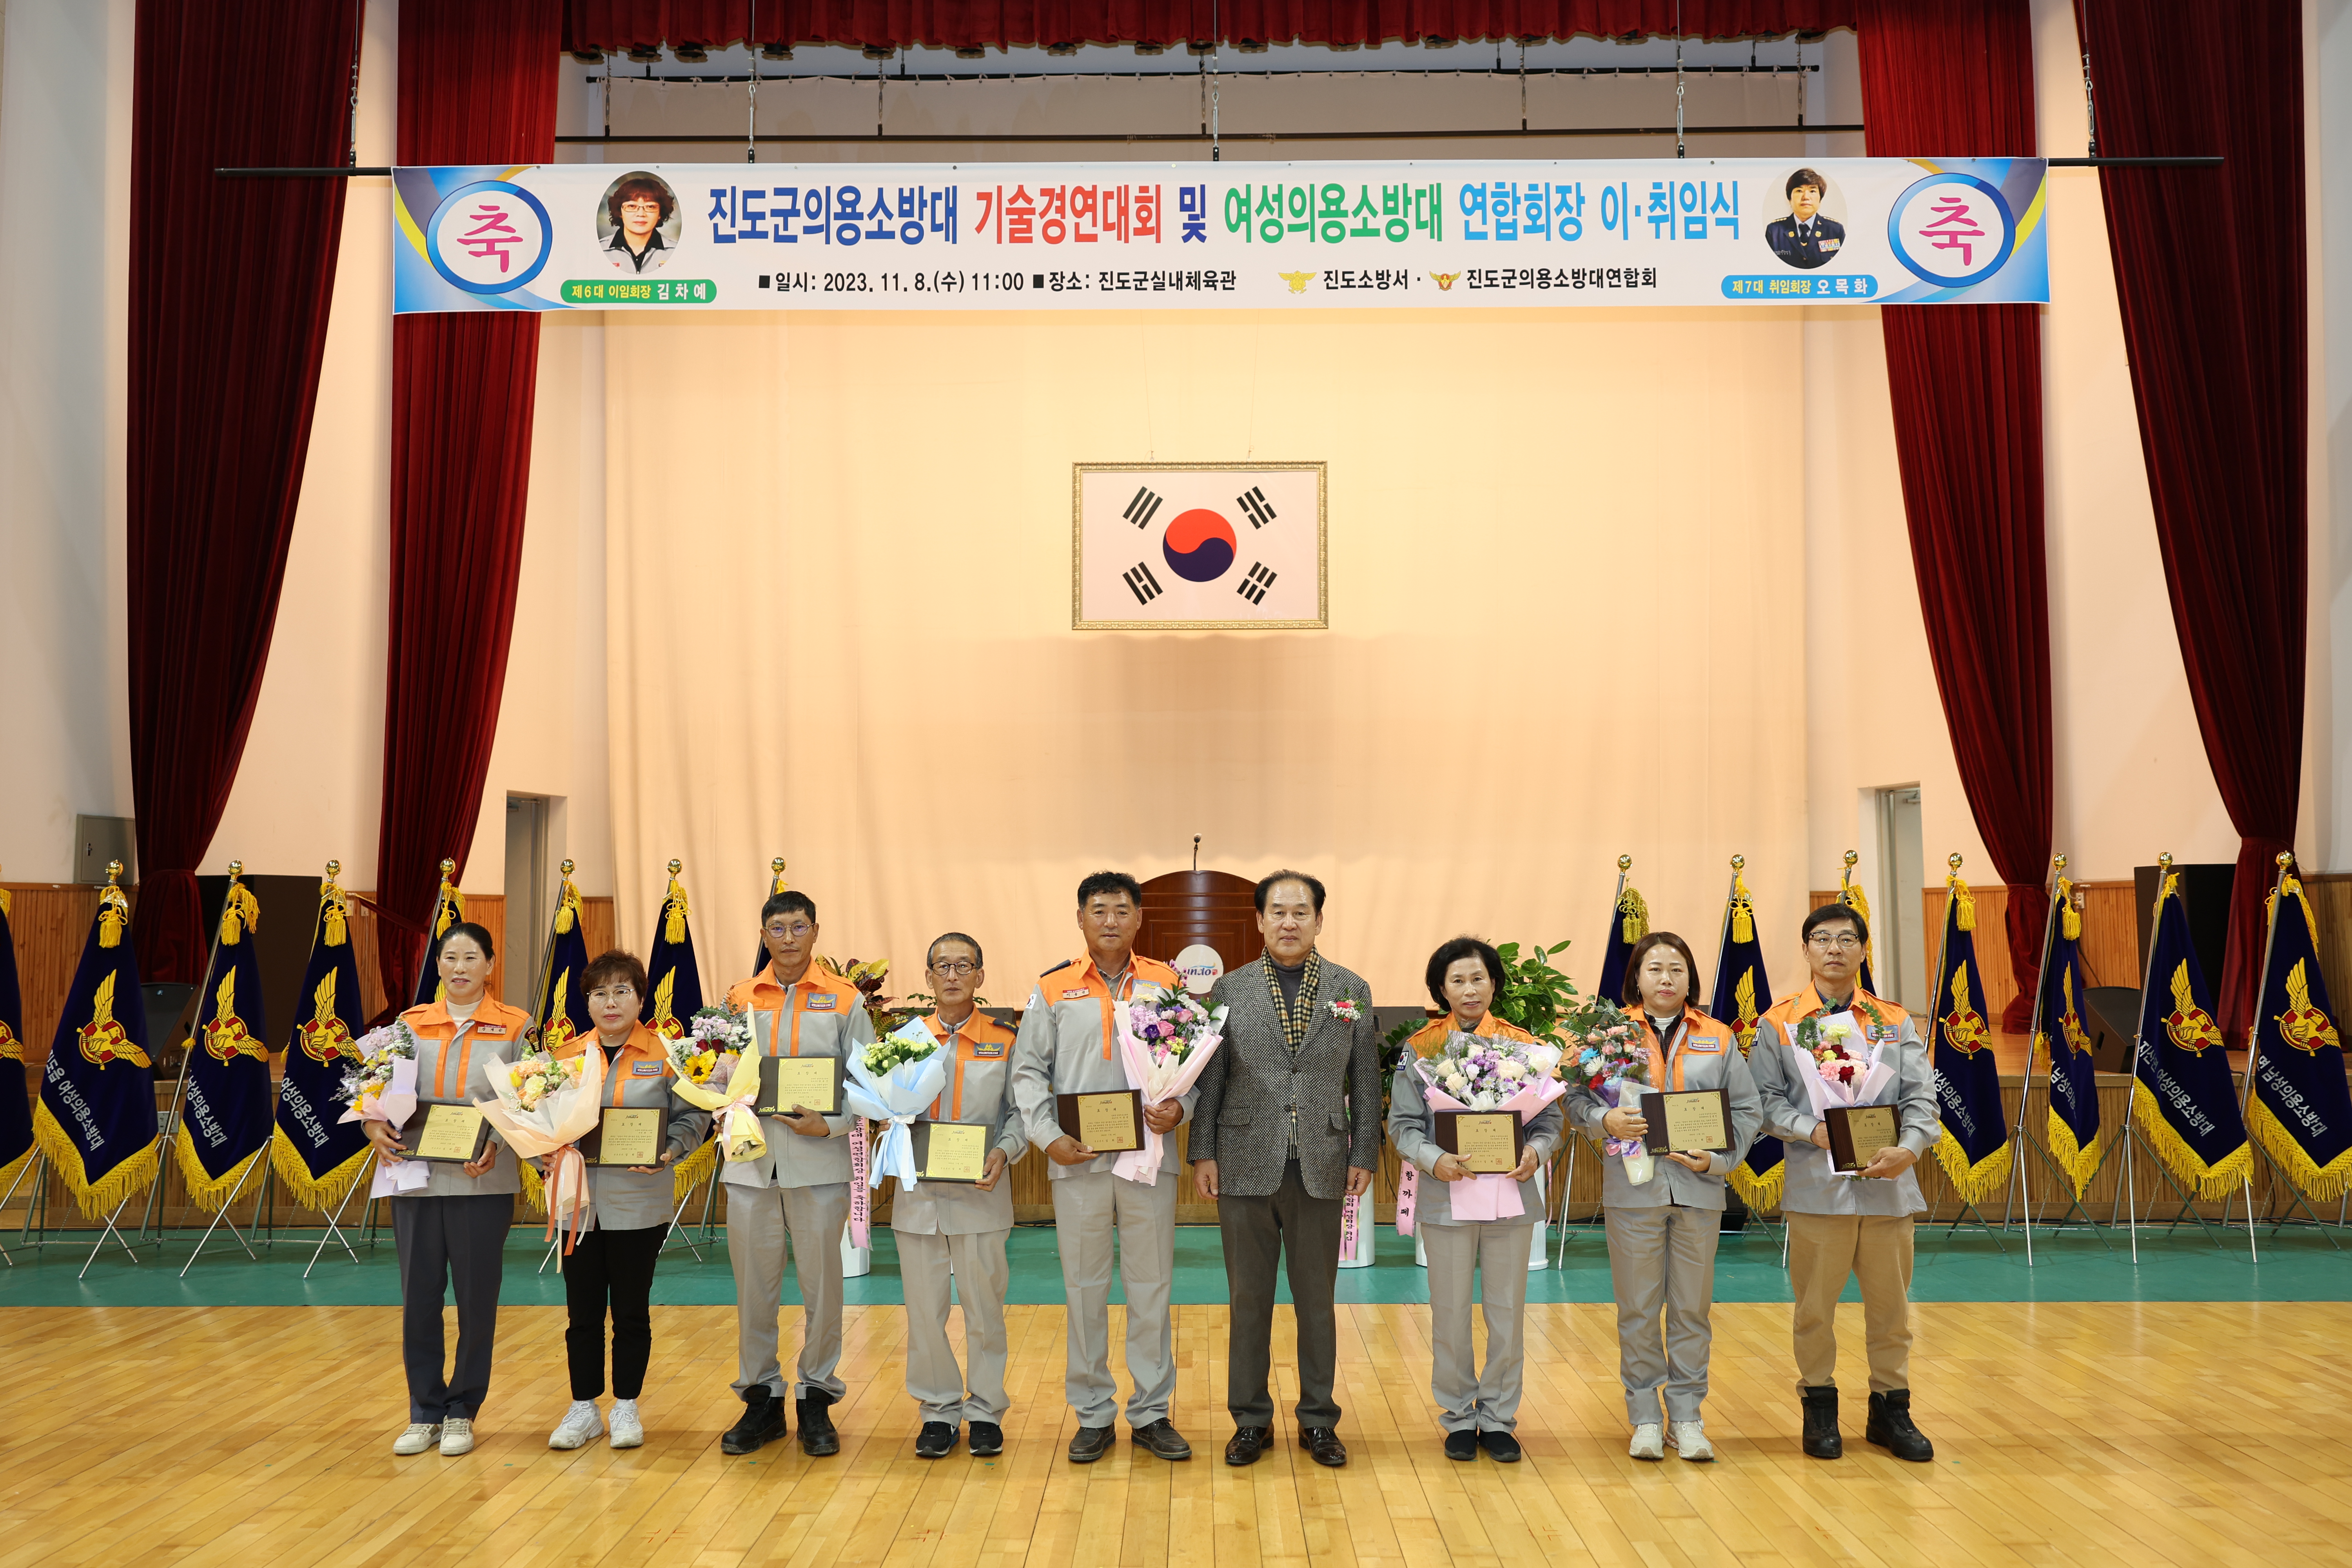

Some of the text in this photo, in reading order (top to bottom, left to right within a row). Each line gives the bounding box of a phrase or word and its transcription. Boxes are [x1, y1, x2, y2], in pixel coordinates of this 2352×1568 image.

[456, 204, 523, 273] 축
[708, 185, 957, 246] 진도군의용소방대
[975, 184, 1161, 245] 기술경연대회
[1179, 184, 1207, 243] 및
[1224, 182, 1442, 244] 여성의용소방대
[1459, 182, 1585, 241] 연합회장
[1919, 196, 1985, 266] 축
[609, 285, 651, 299] 이임회장
[824, 272, 873, 292] 2023.
[881, 272, 907, 292] 11.
[972, 272, 1024, 290] 11:00
[1098, 270, 1236, 291] 진도군실내체육관
[1323, 267, 1656, 290] 진도소방서 진도군의용소방대연합회
[1769, 279, 1812, 294] 취임회장
[58, 1080, 105, 1151] 여성의용소방대
[280, 1077, 330, 1148] 여성의용소방대
[1934, 1068, 1976, 1138] 여성의용소방대
[2139, 1041, 2215, 1137] 지산면 여성의용소방대
[2261, 1066, 2328, 1138] 남성의용소방대
[852, 1141, 865, 1173] 여성연합회장
[853, 1195, 866, 1222] 축하합니다
